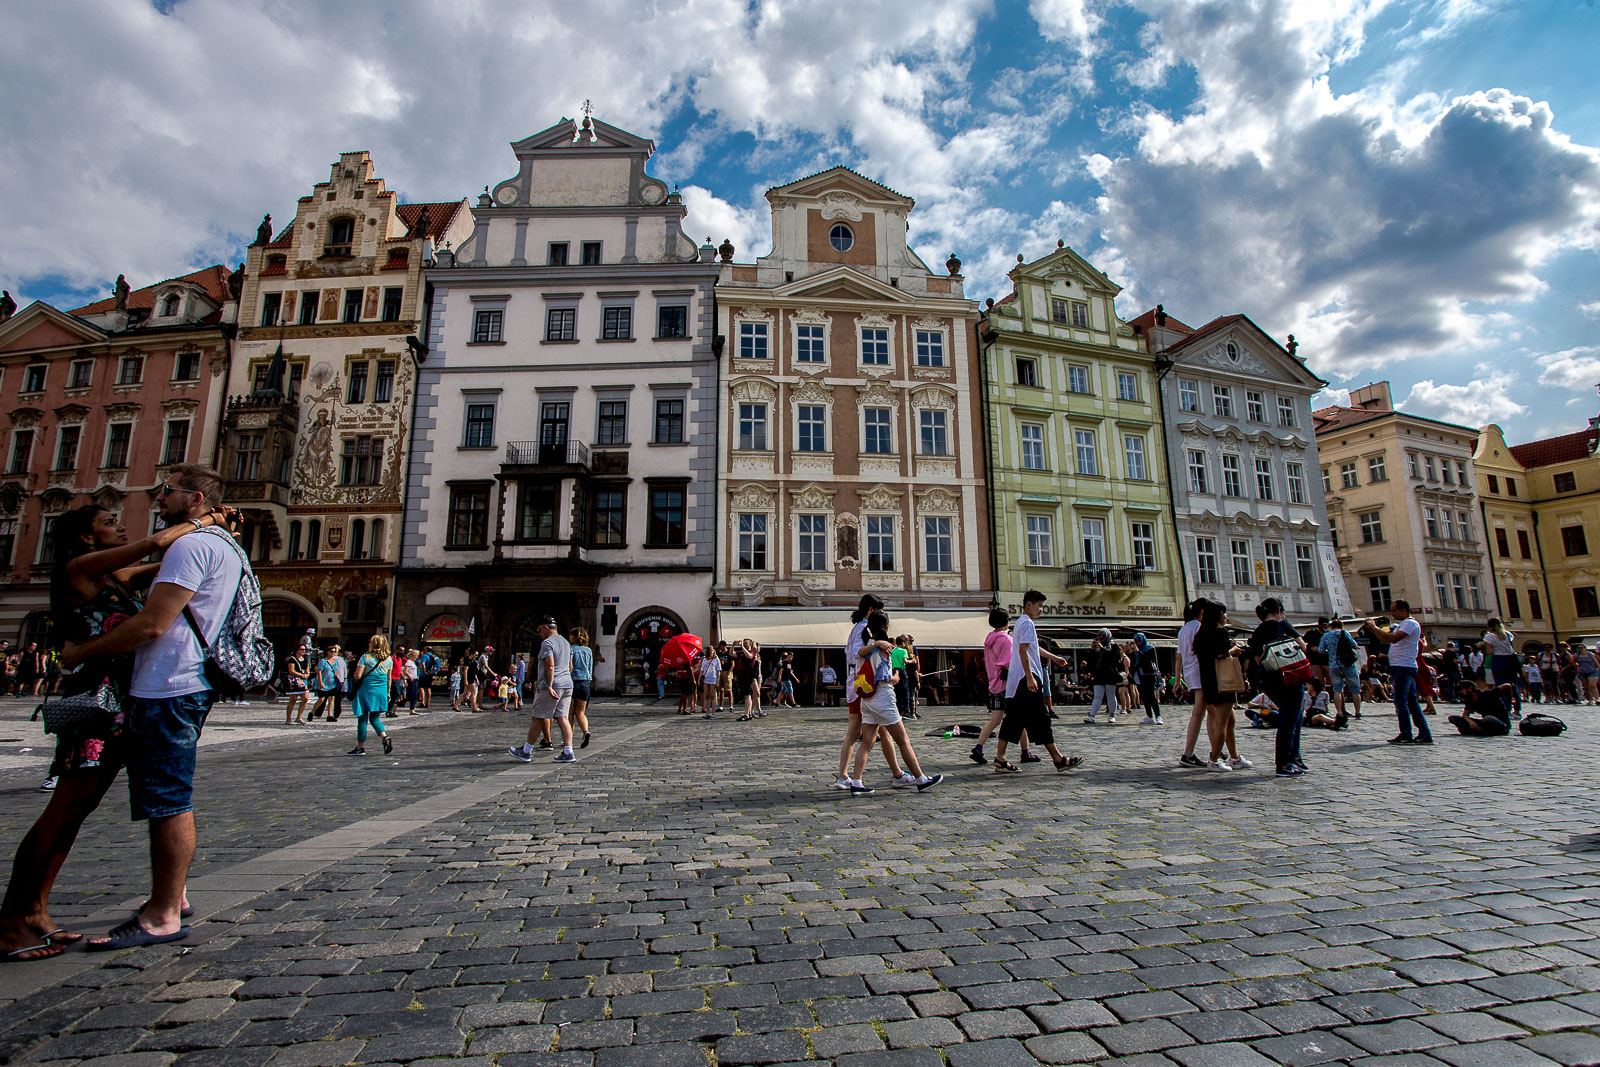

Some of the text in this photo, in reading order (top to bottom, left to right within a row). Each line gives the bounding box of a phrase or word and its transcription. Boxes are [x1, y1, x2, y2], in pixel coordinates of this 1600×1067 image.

[1325, 552, 1343, 607] HOTEL
[1008, 601, 1106, 616] STOMĚSTSKÁ
[634, 615, 676, 629] SOUVENIR SHOP
